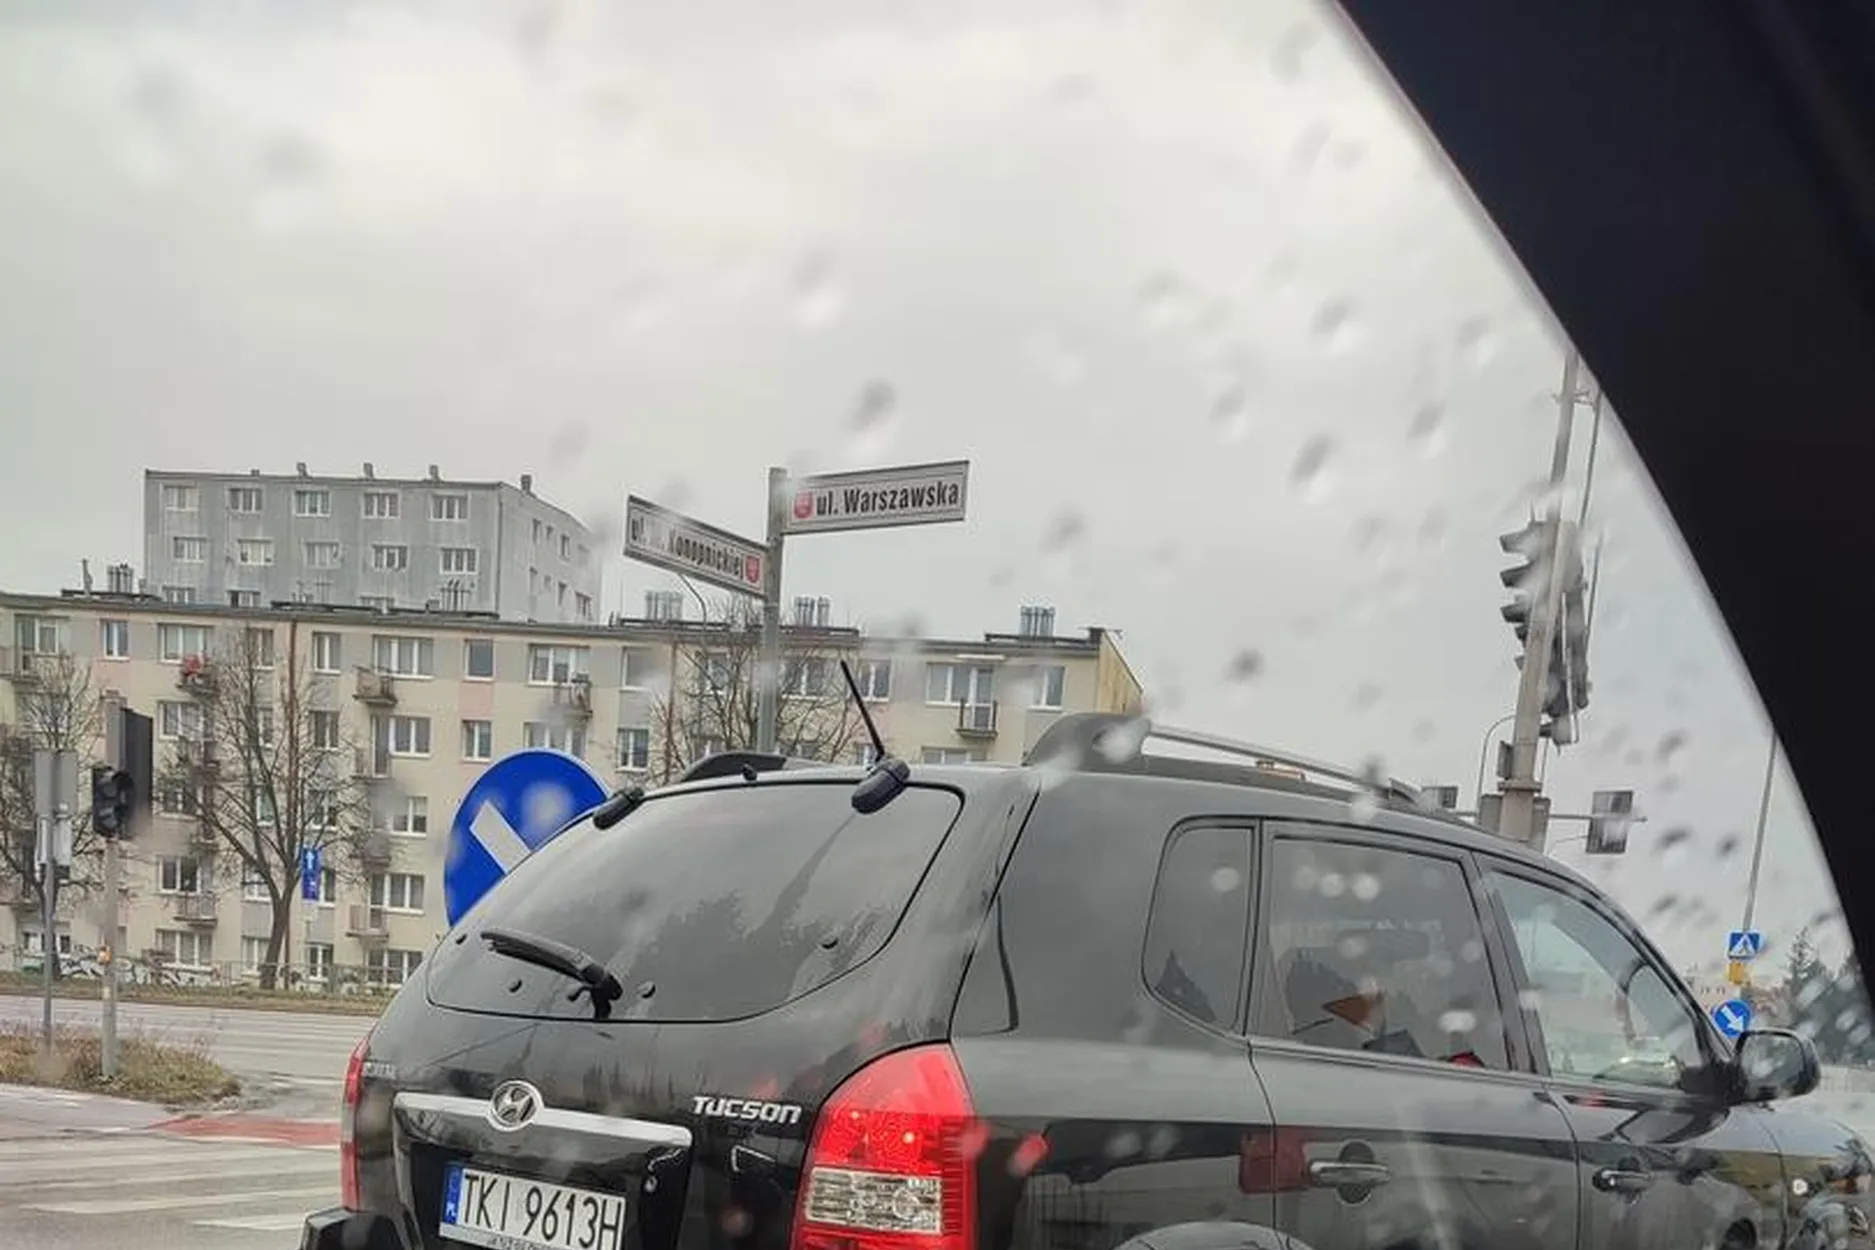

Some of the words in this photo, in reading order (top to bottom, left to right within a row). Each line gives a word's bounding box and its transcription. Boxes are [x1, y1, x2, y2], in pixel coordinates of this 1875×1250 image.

[816, 491, 838, 516] ul.
[844, 480, 959, 514] Warszawska
[464, 1174, 510, 1231] TKI
